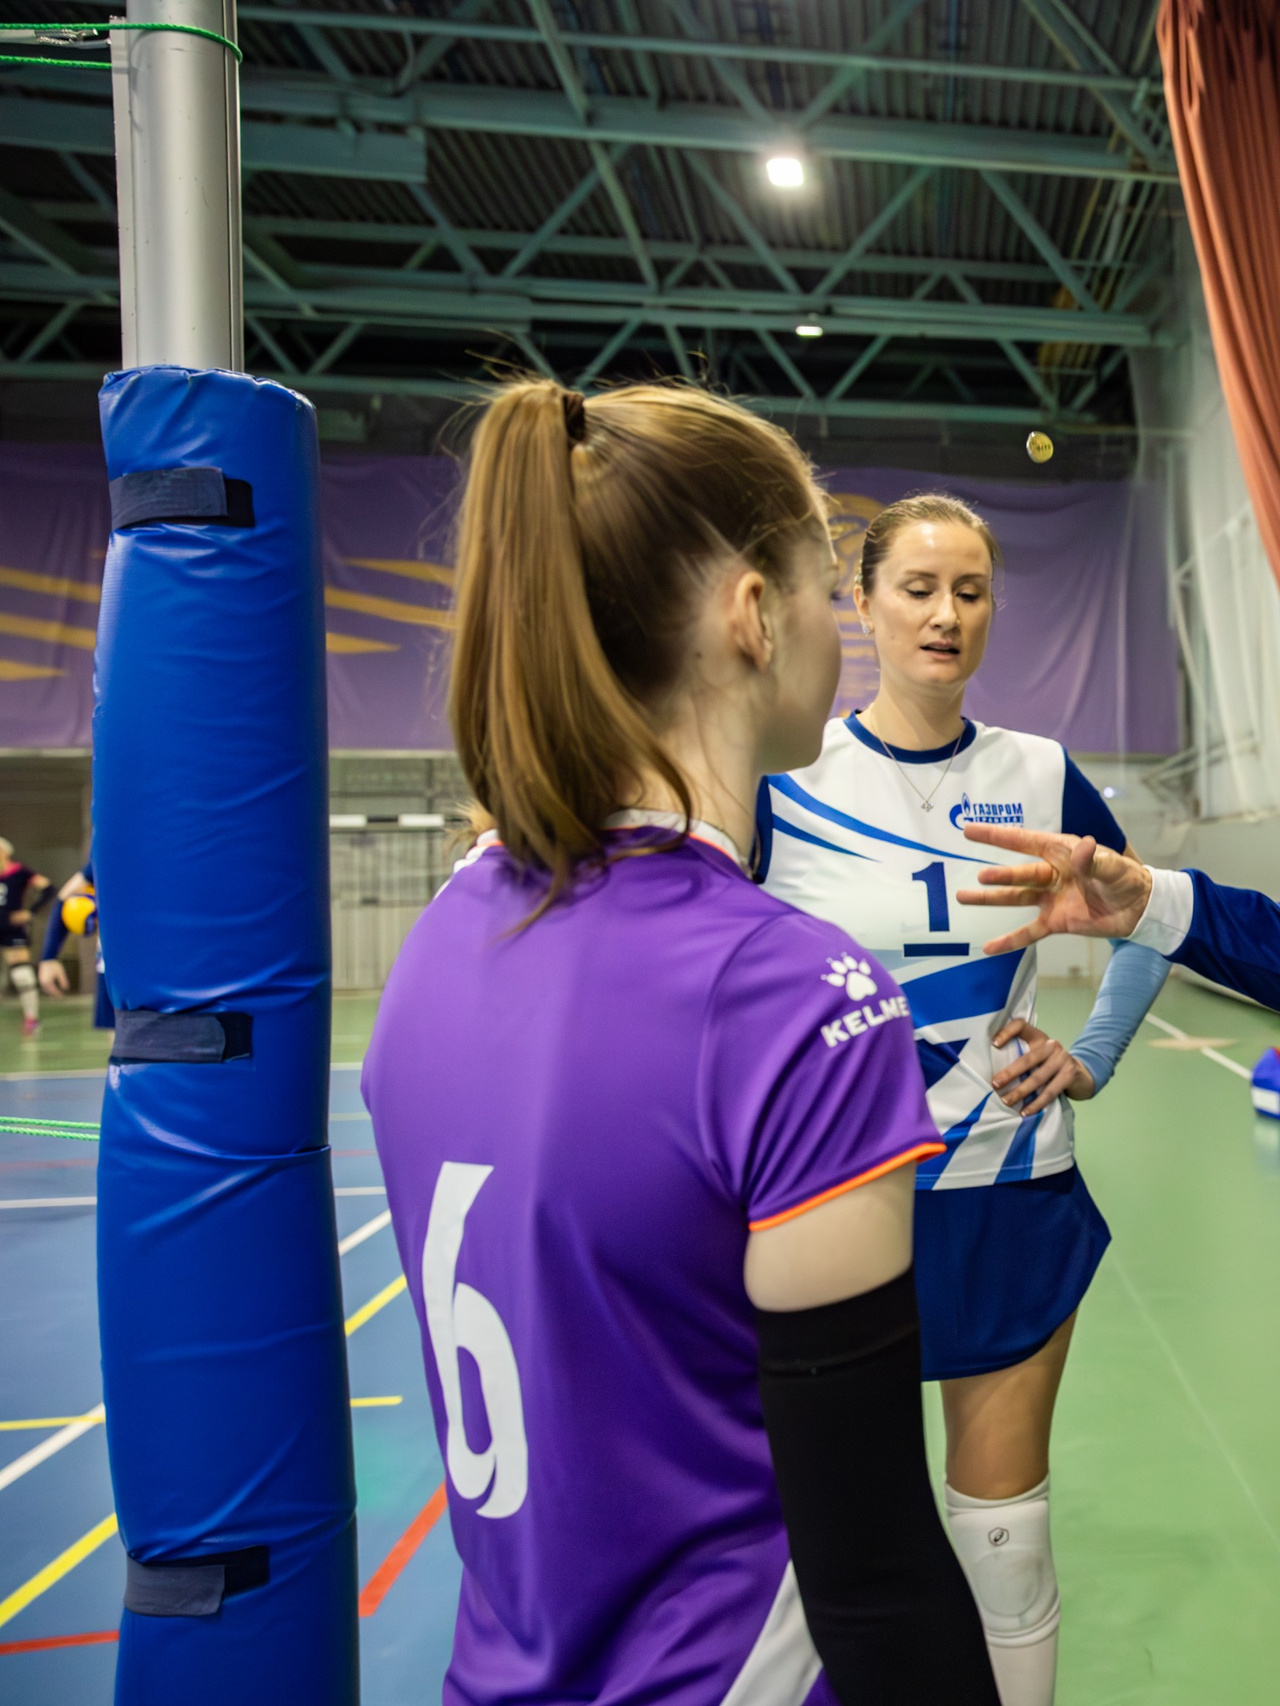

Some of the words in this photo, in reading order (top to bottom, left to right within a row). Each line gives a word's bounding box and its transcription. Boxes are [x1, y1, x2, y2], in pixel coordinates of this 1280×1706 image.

[972, 802, 1024, 816] ГАЗПРОМ
[911, 861, 950, 932] 1
[820, 995, 911, 1048] KELME
[422, 1161, 529, 1519] 6
